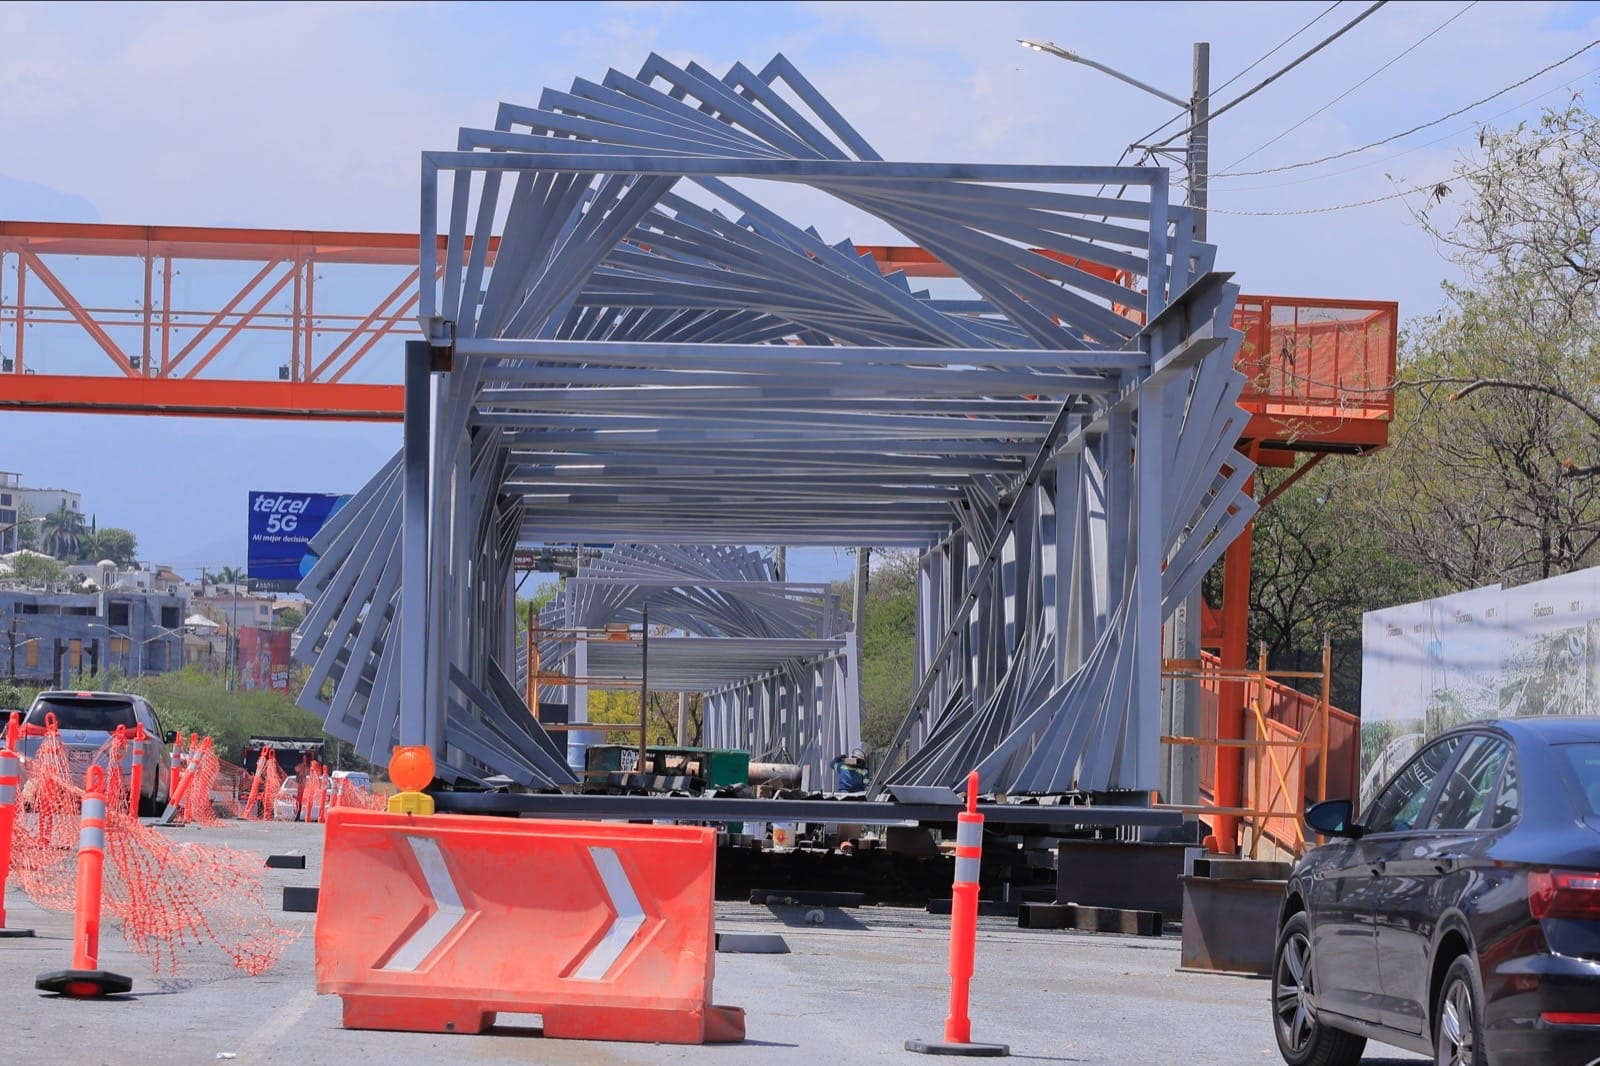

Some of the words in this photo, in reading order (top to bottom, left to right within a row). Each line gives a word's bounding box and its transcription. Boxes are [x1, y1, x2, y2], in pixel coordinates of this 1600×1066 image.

[253, 495, 311, 514] telcel
[266, 514, 298, 533] 5G
[252, 533, 262, 541] Mi
[263, 535, 282, 543] mejor
[282, 534, 309, 543] decisión
